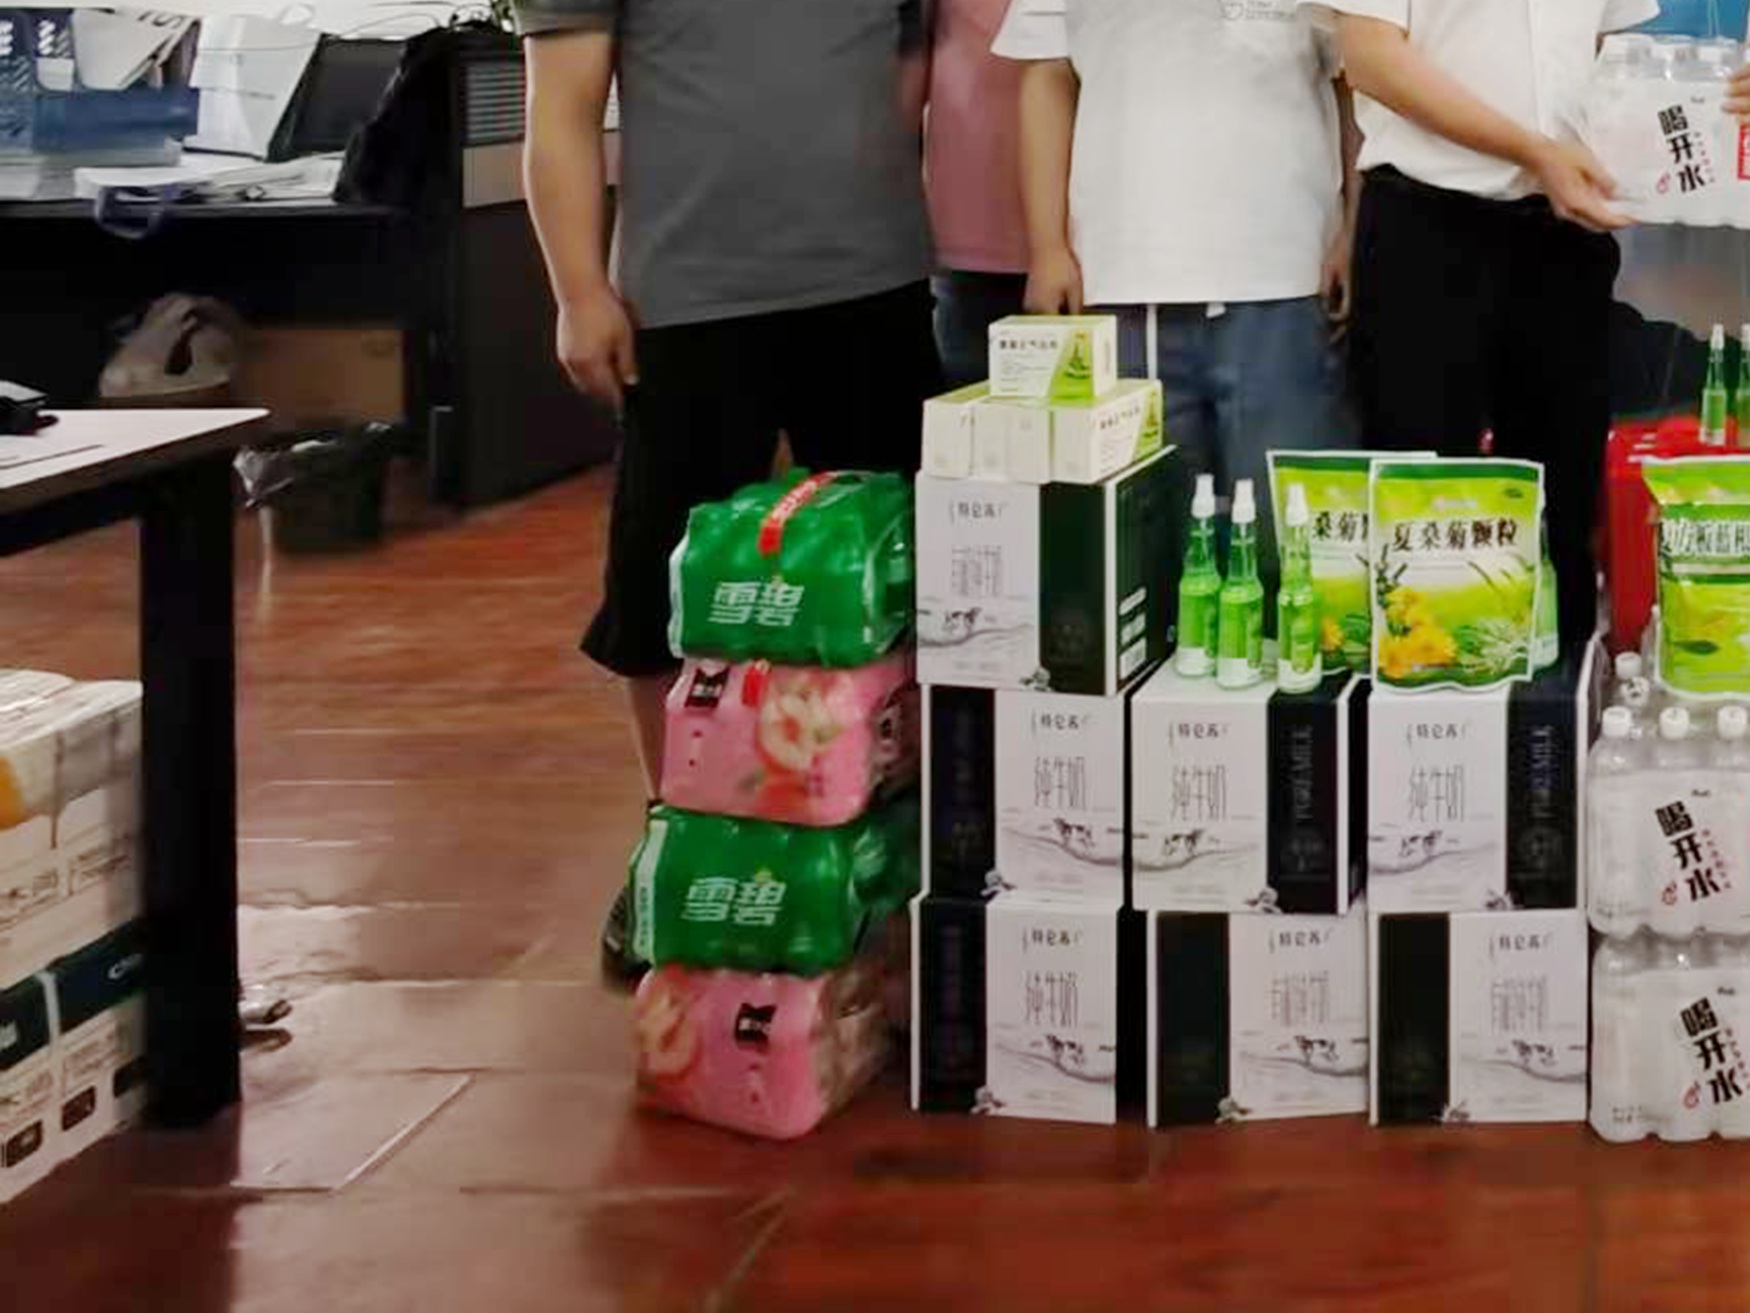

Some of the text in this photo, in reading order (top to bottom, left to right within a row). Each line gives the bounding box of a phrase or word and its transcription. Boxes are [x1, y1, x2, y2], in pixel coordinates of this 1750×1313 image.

[1657, 104, 1706, 193] 喝开水
[1393, 516, 1518, 552] 夏桑菊颗粒
[708, 581, 805, 627] 雪碧
[1655, 800, 1721, 902] 喝开水
[681, 876, 787, 926] 雪碧
[1680, 997, 1743, 1104] 喝开水
